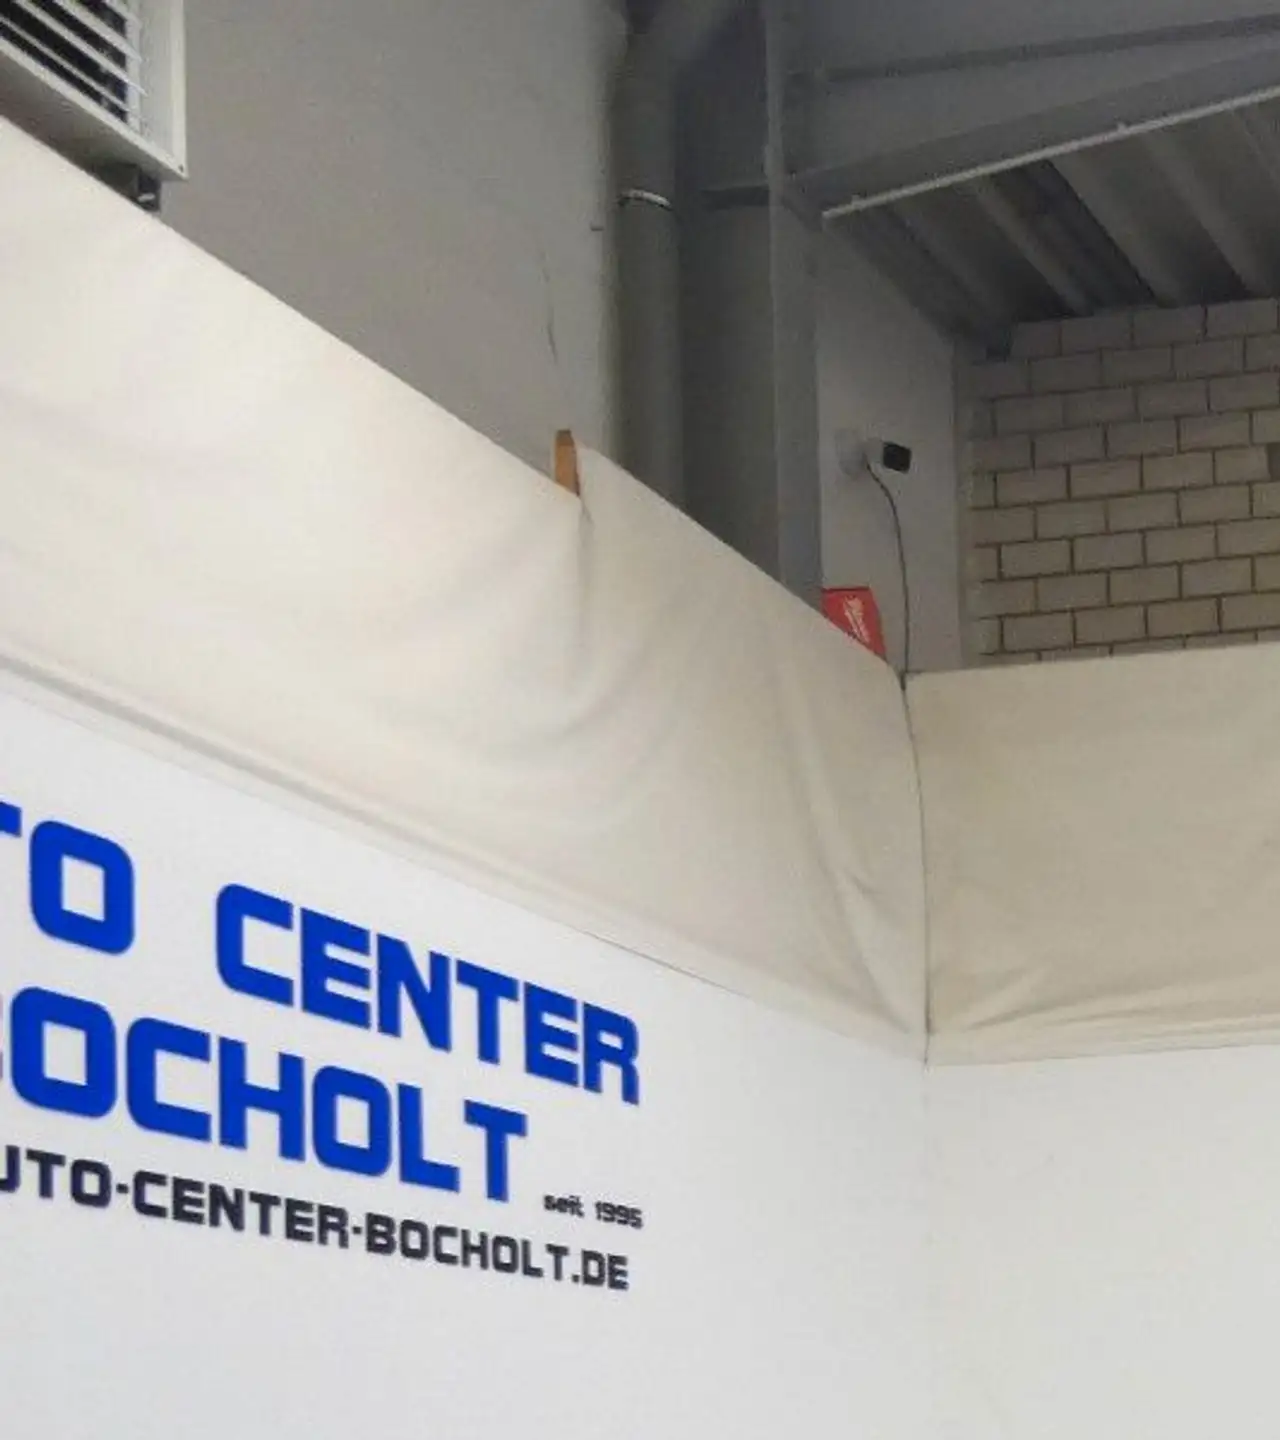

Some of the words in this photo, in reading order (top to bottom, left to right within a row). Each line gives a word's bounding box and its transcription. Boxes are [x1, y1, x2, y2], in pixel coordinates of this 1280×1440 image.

[0, 801, 137, 956] O
[215, 883, 641, 1105] CENTER
[0, 986, 528, 1202] OCHOLT
[543, 1194, 584, 1218] seit
[594, 1200, 644, 1229] 1995
